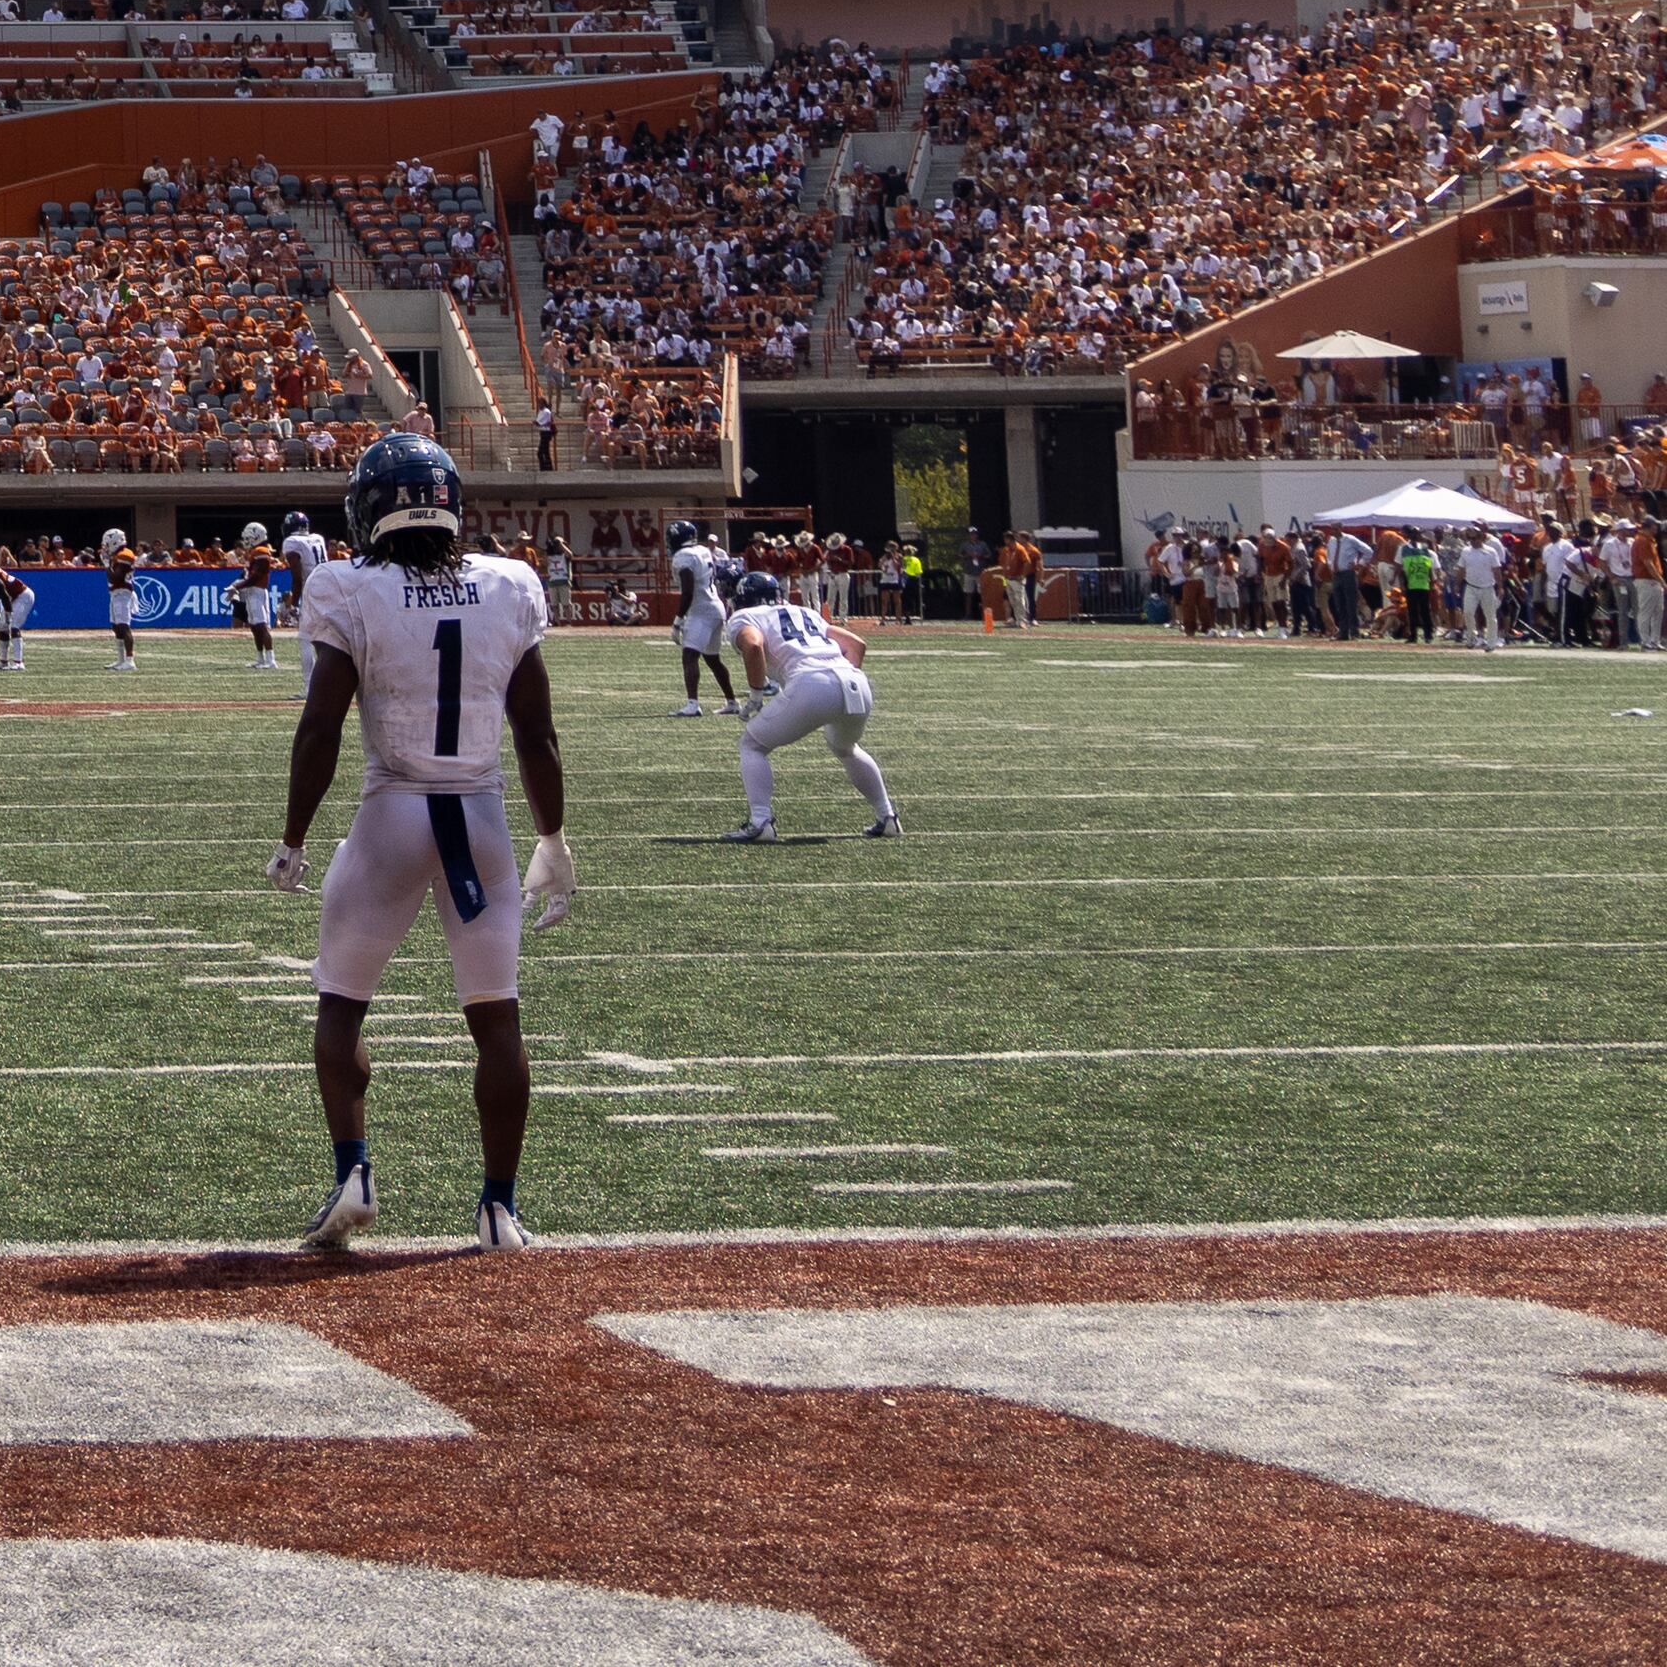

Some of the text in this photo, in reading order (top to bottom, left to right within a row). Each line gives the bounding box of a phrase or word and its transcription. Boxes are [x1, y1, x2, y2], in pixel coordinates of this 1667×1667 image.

[409, 510, 437, 520] OWLS
[403, 582, 480, 608] FRESCH
[778, 608, 832, 646] 44
[432, 618, 462, 757] 1
